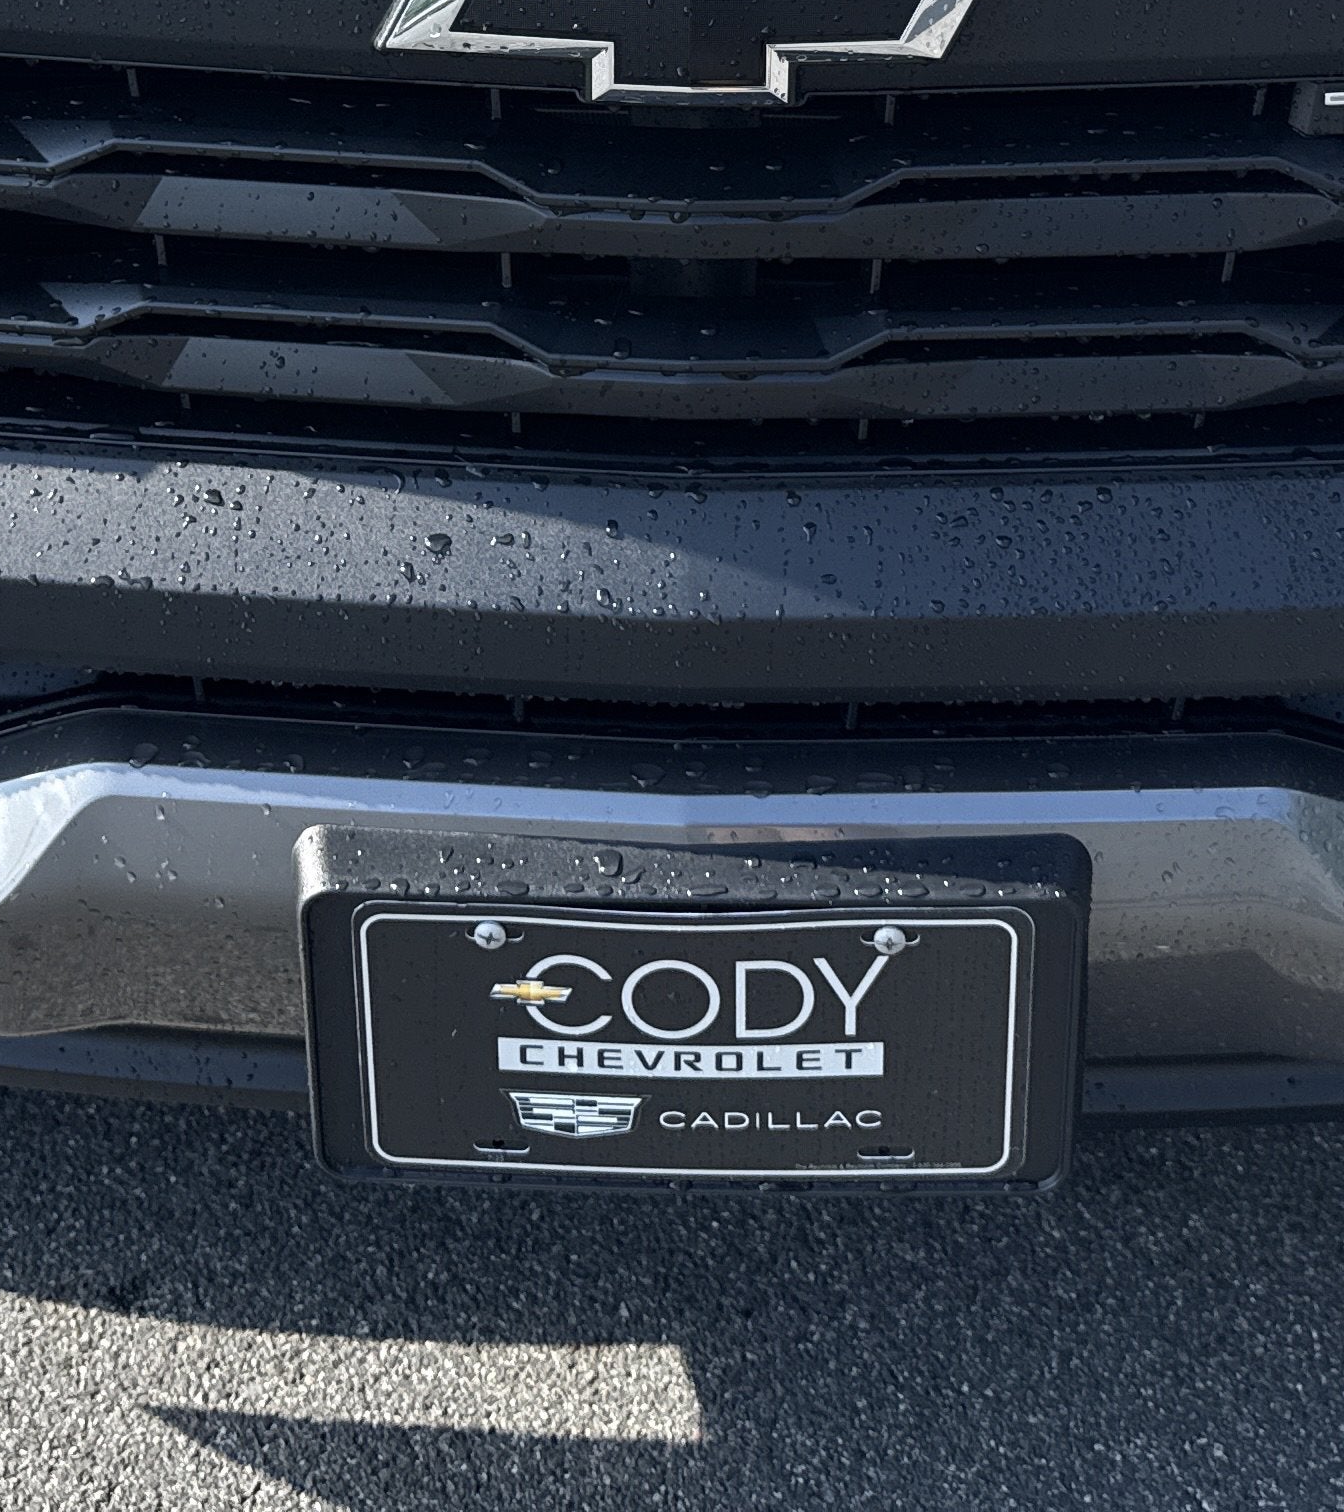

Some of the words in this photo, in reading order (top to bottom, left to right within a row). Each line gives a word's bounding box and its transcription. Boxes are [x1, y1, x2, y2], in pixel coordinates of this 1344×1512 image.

[524, 953, 890, 1040] CODY
[518, 1043, 864, 1072] CHEVROLET
[658, 1109, 883, 1131] CADILLAC
